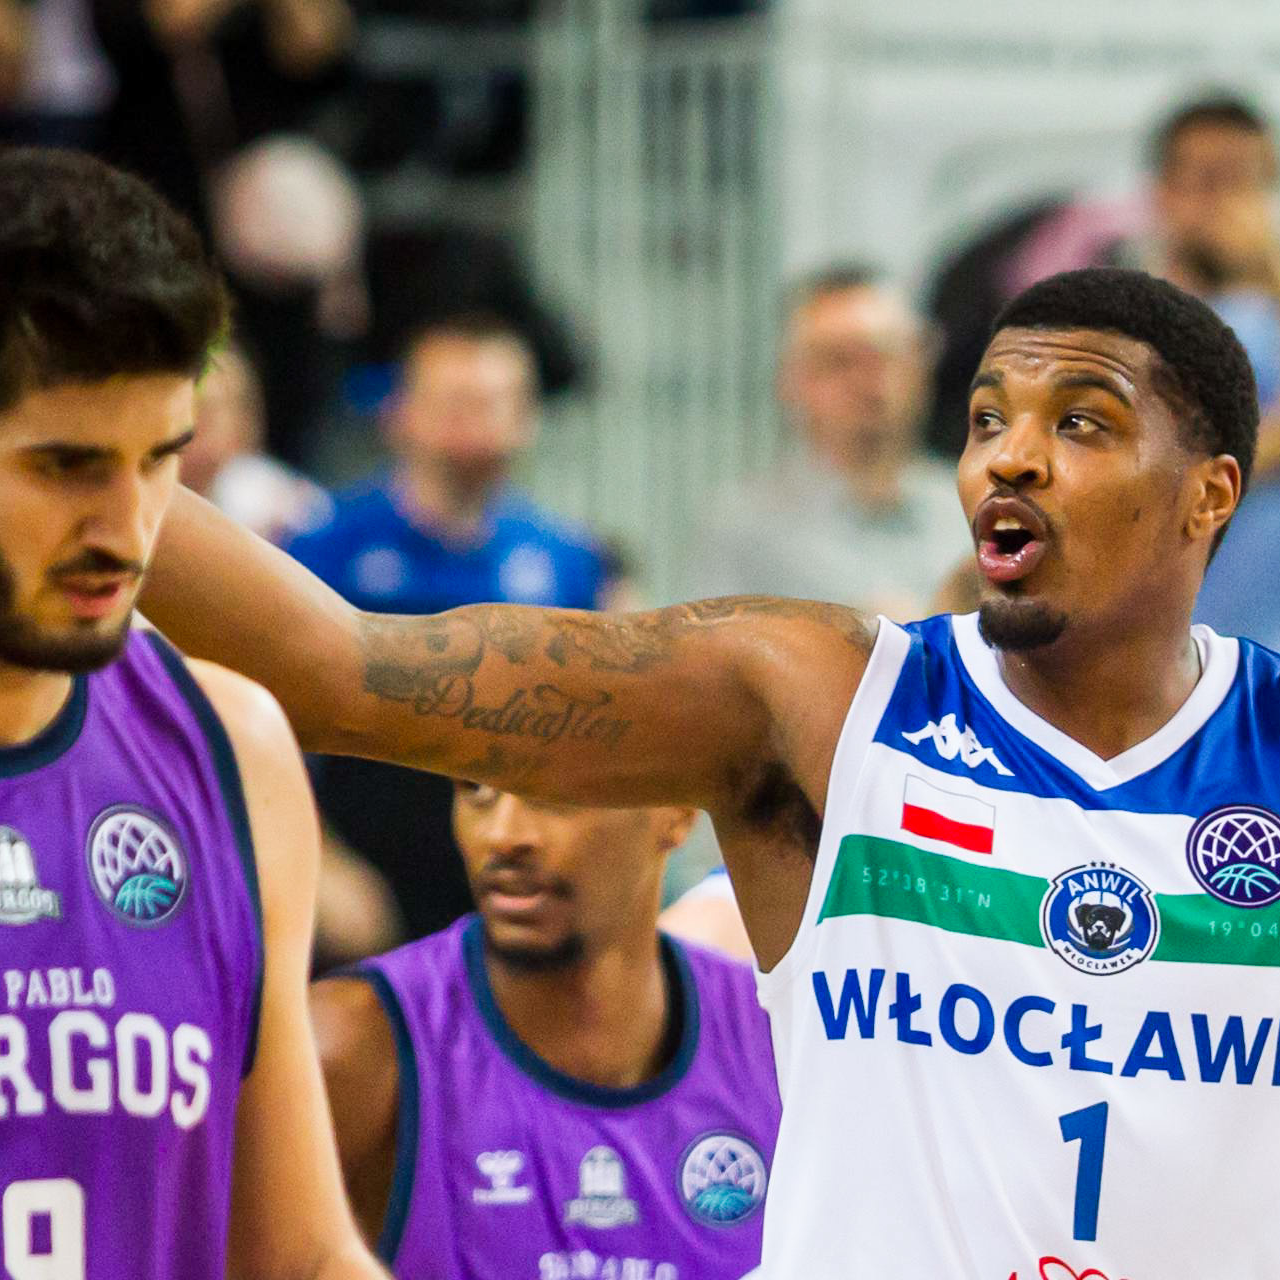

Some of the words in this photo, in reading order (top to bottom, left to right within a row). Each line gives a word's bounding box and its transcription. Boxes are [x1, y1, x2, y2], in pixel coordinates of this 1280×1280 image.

[1068, 872, 1140, 904] ANWIL
[7, 968, 115, 1006] PABLO
[1058, 1100, 1109, 1242] 1
